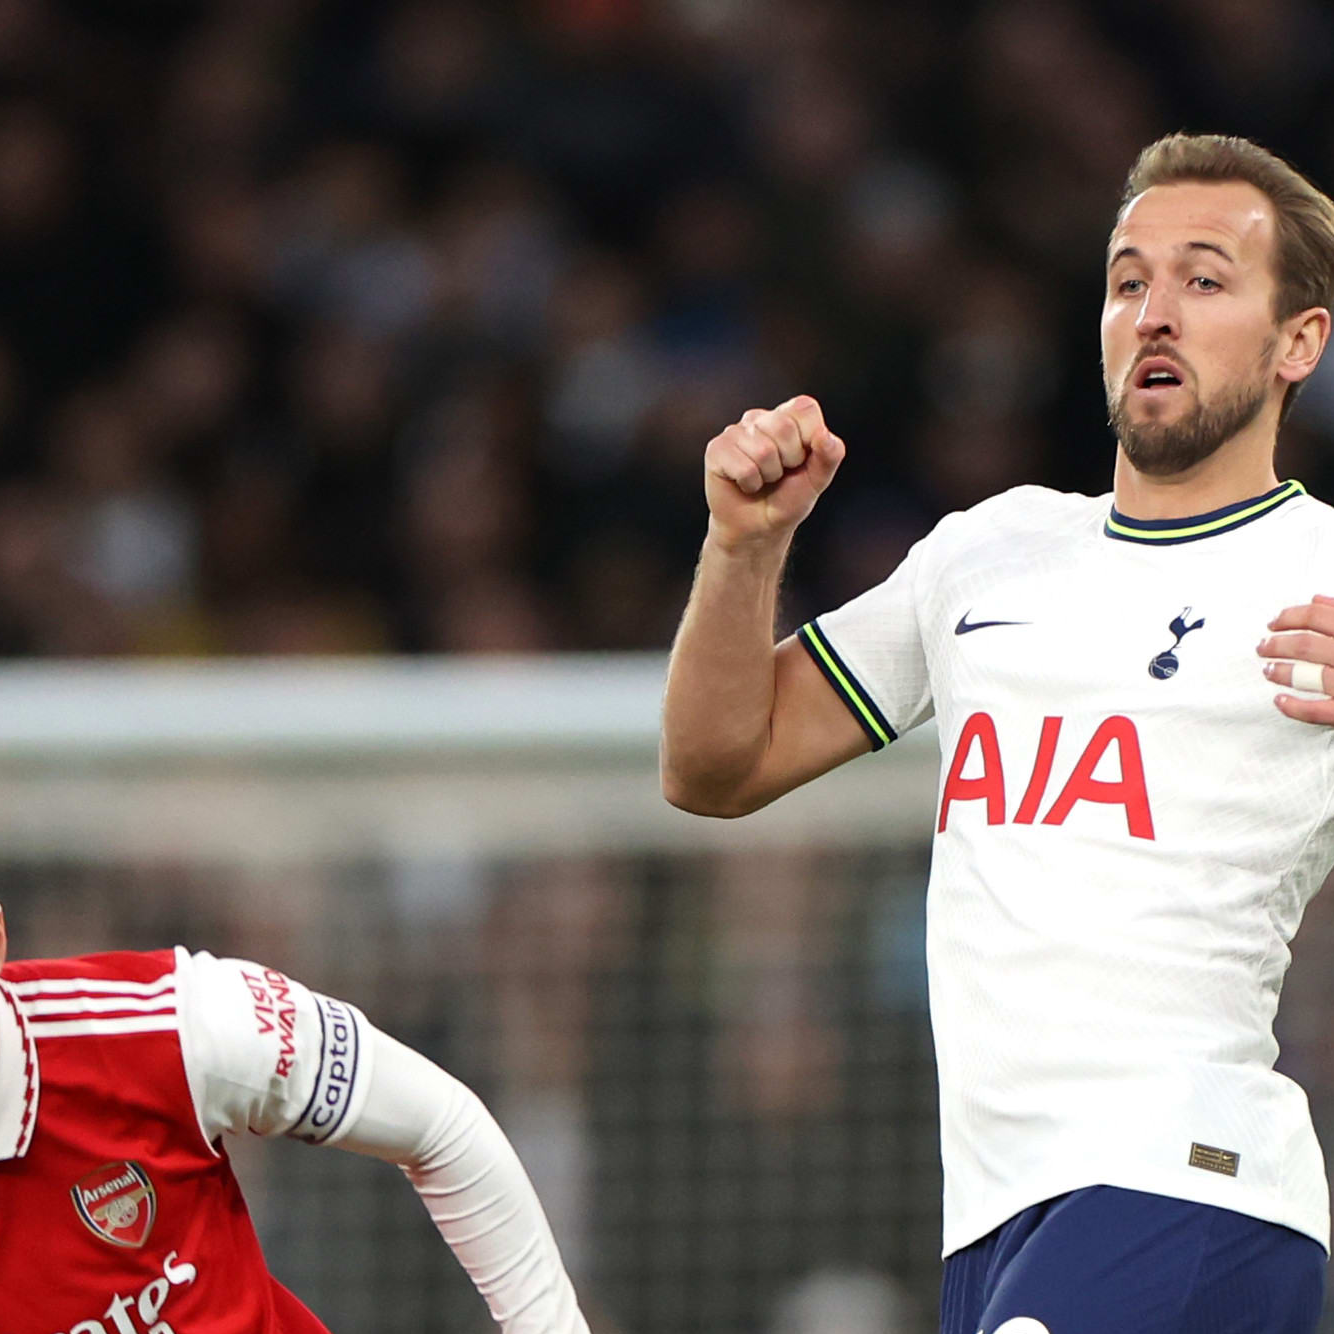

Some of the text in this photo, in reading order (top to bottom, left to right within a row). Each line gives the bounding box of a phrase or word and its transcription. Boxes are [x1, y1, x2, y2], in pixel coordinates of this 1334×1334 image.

[937, 711, 1156, 842] AIA
[240, 969, 274, 1035] VISIT
[83, 1168, 137, 1207] Arsenal
